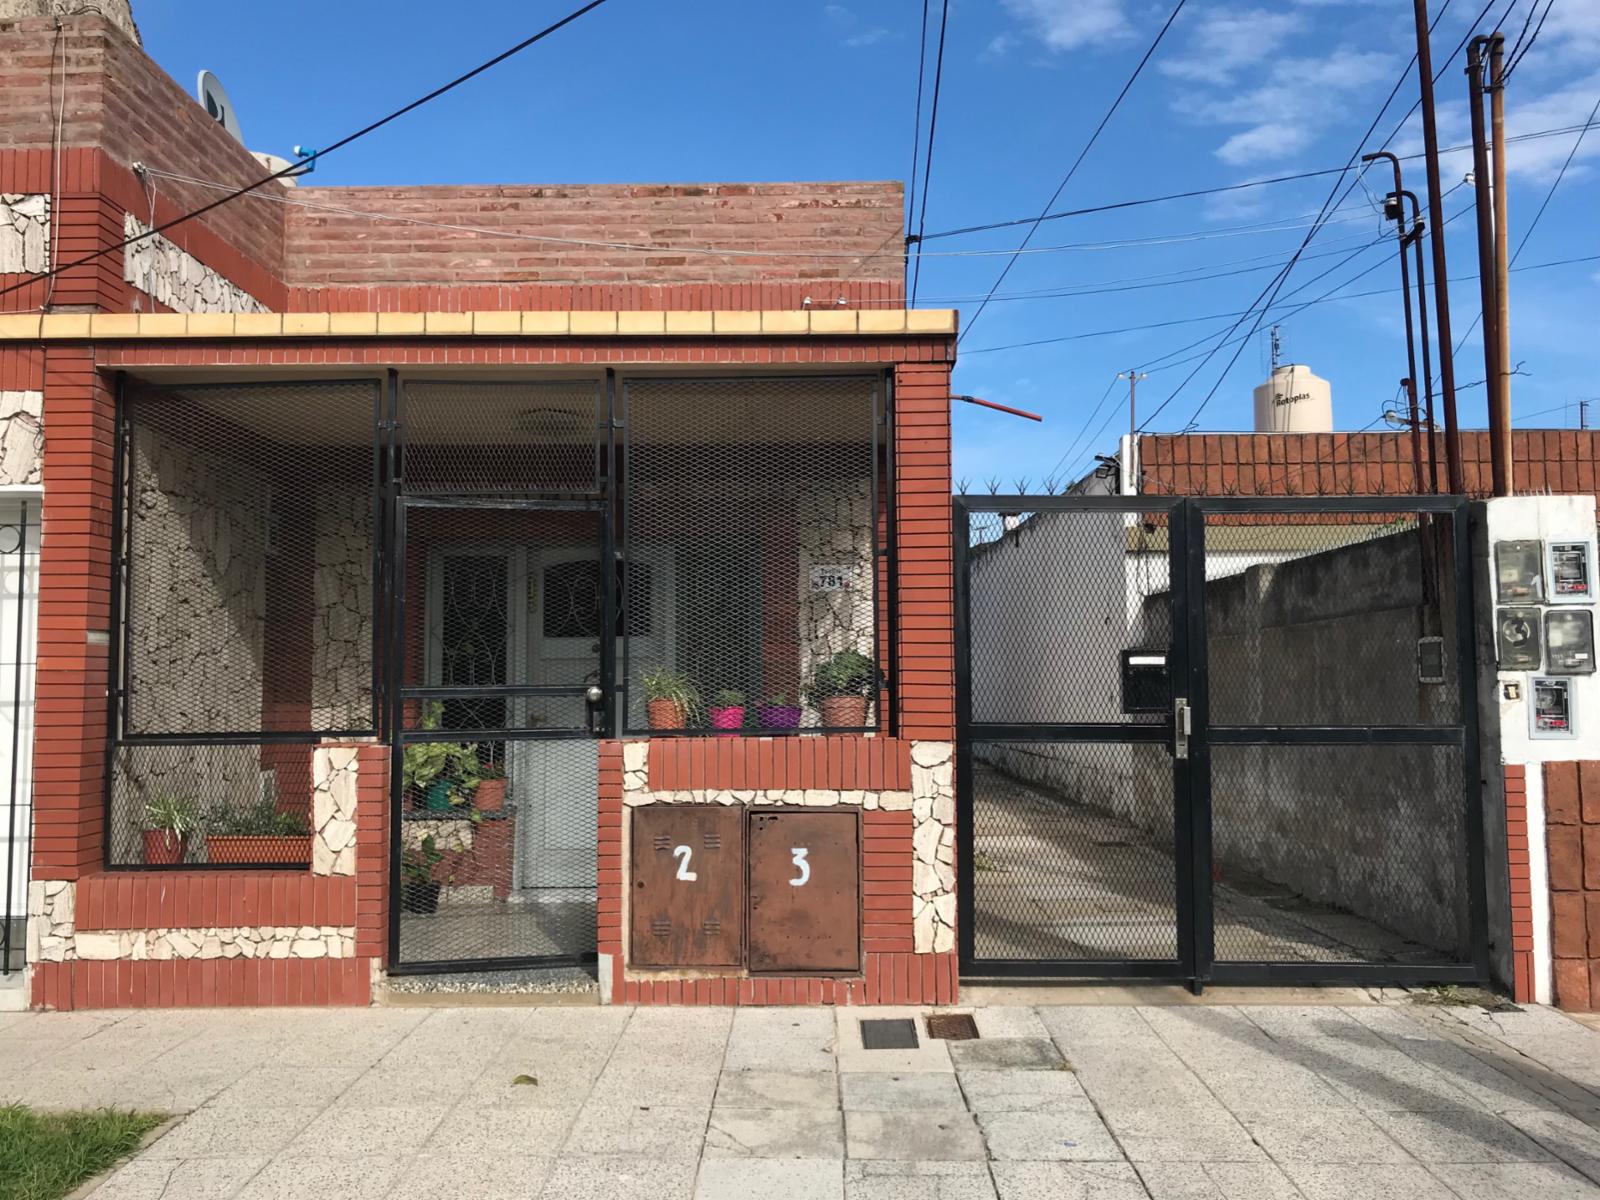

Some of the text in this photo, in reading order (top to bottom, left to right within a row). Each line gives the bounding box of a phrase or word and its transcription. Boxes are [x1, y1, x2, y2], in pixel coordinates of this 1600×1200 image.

[1276, 393, 1311, 407] Rotoplas
[673, 845, 698, 882] 2
[789, 847, 811, 886] 3
